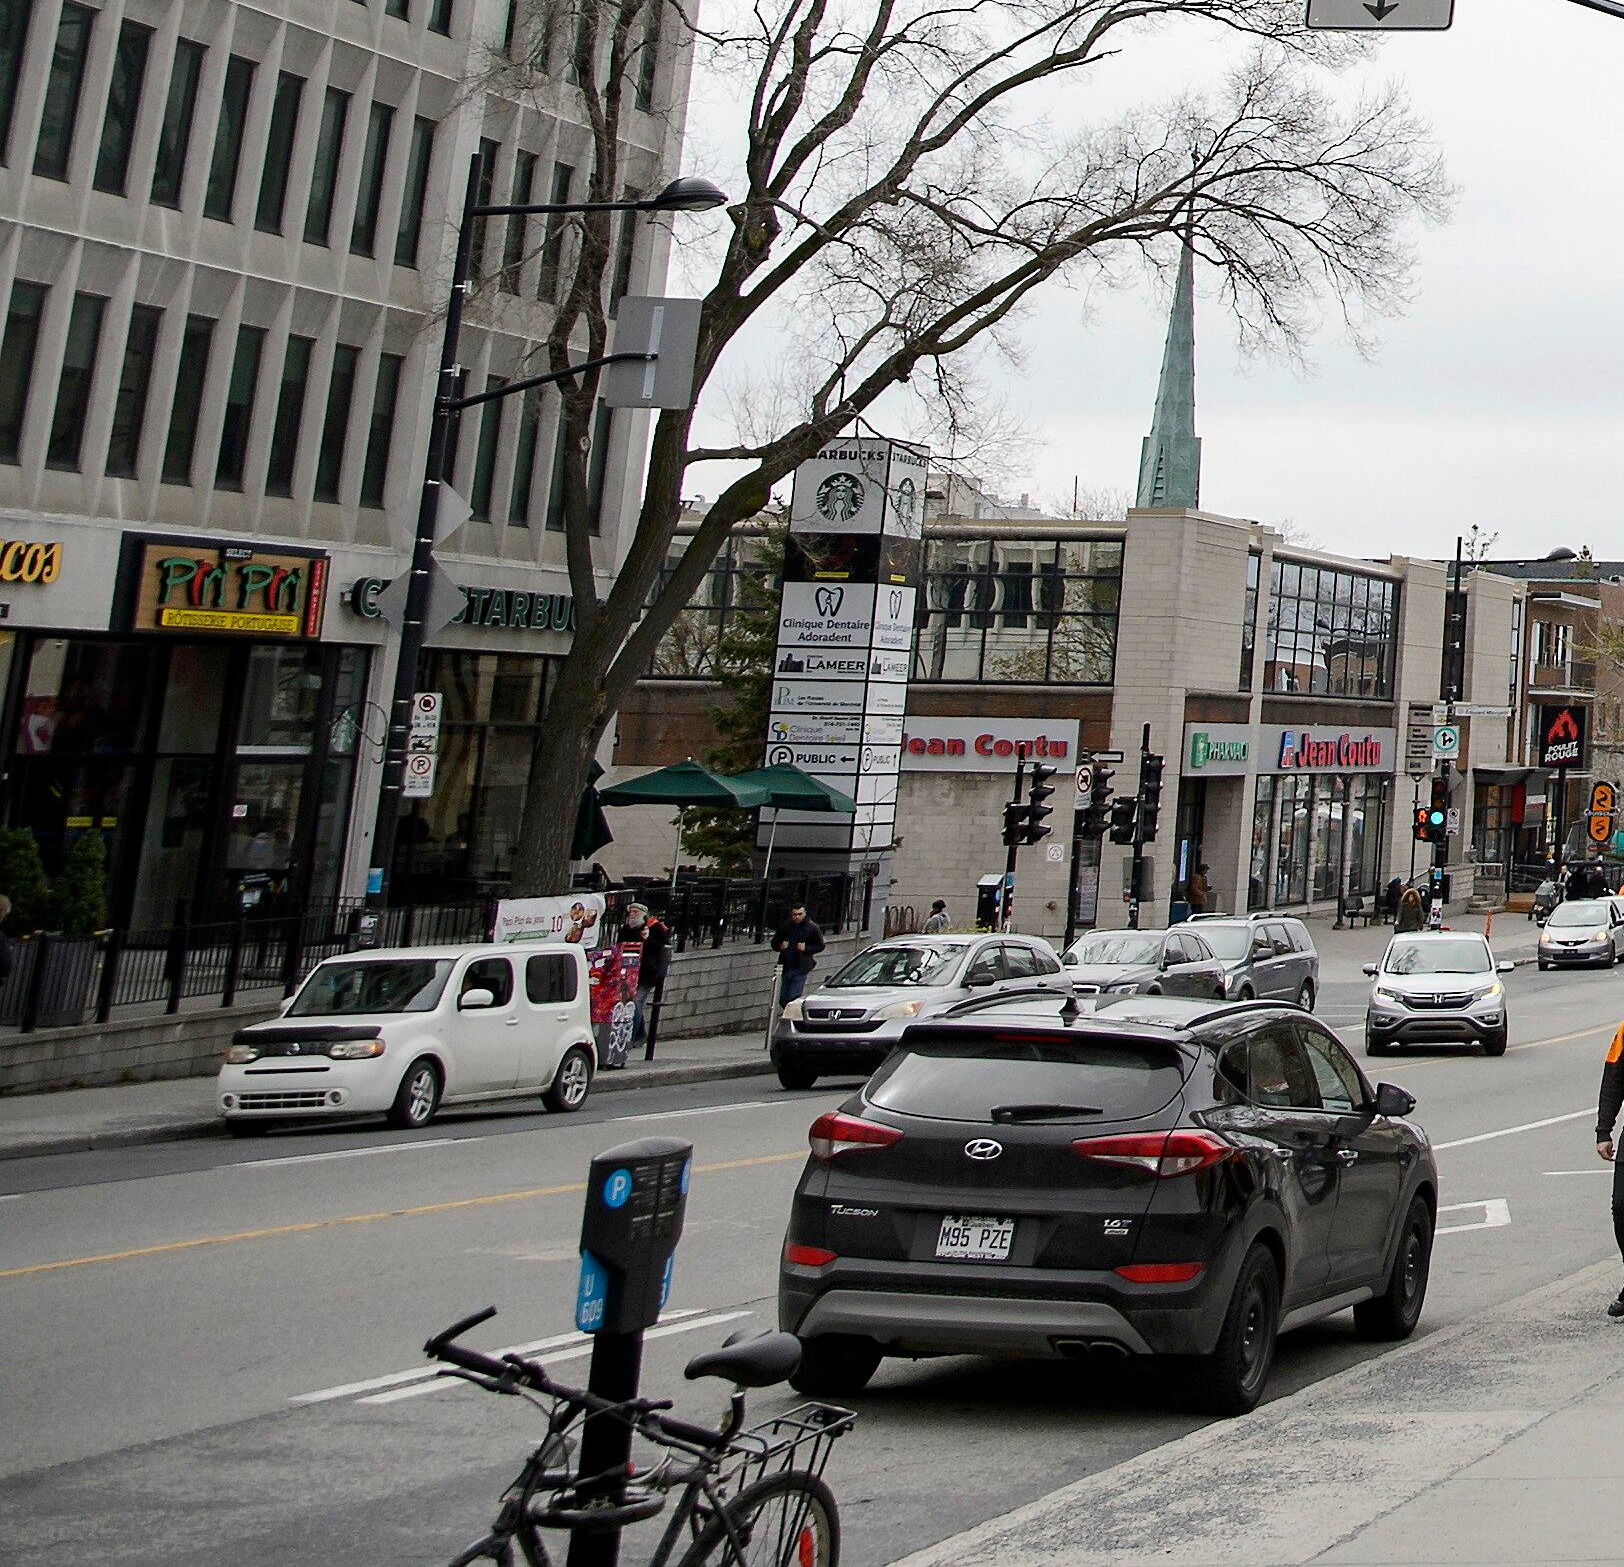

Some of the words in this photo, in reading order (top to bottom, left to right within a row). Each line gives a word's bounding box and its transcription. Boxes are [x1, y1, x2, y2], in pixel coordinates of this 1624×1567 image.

[817, 450, 885, 461] ARBUCKS
[450, 585, 576, 631] TARBU
[783, 618, 823, 630] Clinique
[826, 619, 870, 630] Dentaire
[797, 632, 852, 643] Adoradent
[806, 658, 866, 671] LAMEER
[900, 732, 966, 755] Jean
[1297, 733, 1336, 768] Jean
[1338, 733, 1382, 767] Coutu
[1548, 741, 1578, 753] POULET
[796, 753, 836, 764] PUBLIC
[1544, 747, 1579, 763] ROUGE
[610, 1175, 627, 1201] P
[979, 1228, 1012, 1249] PZE
